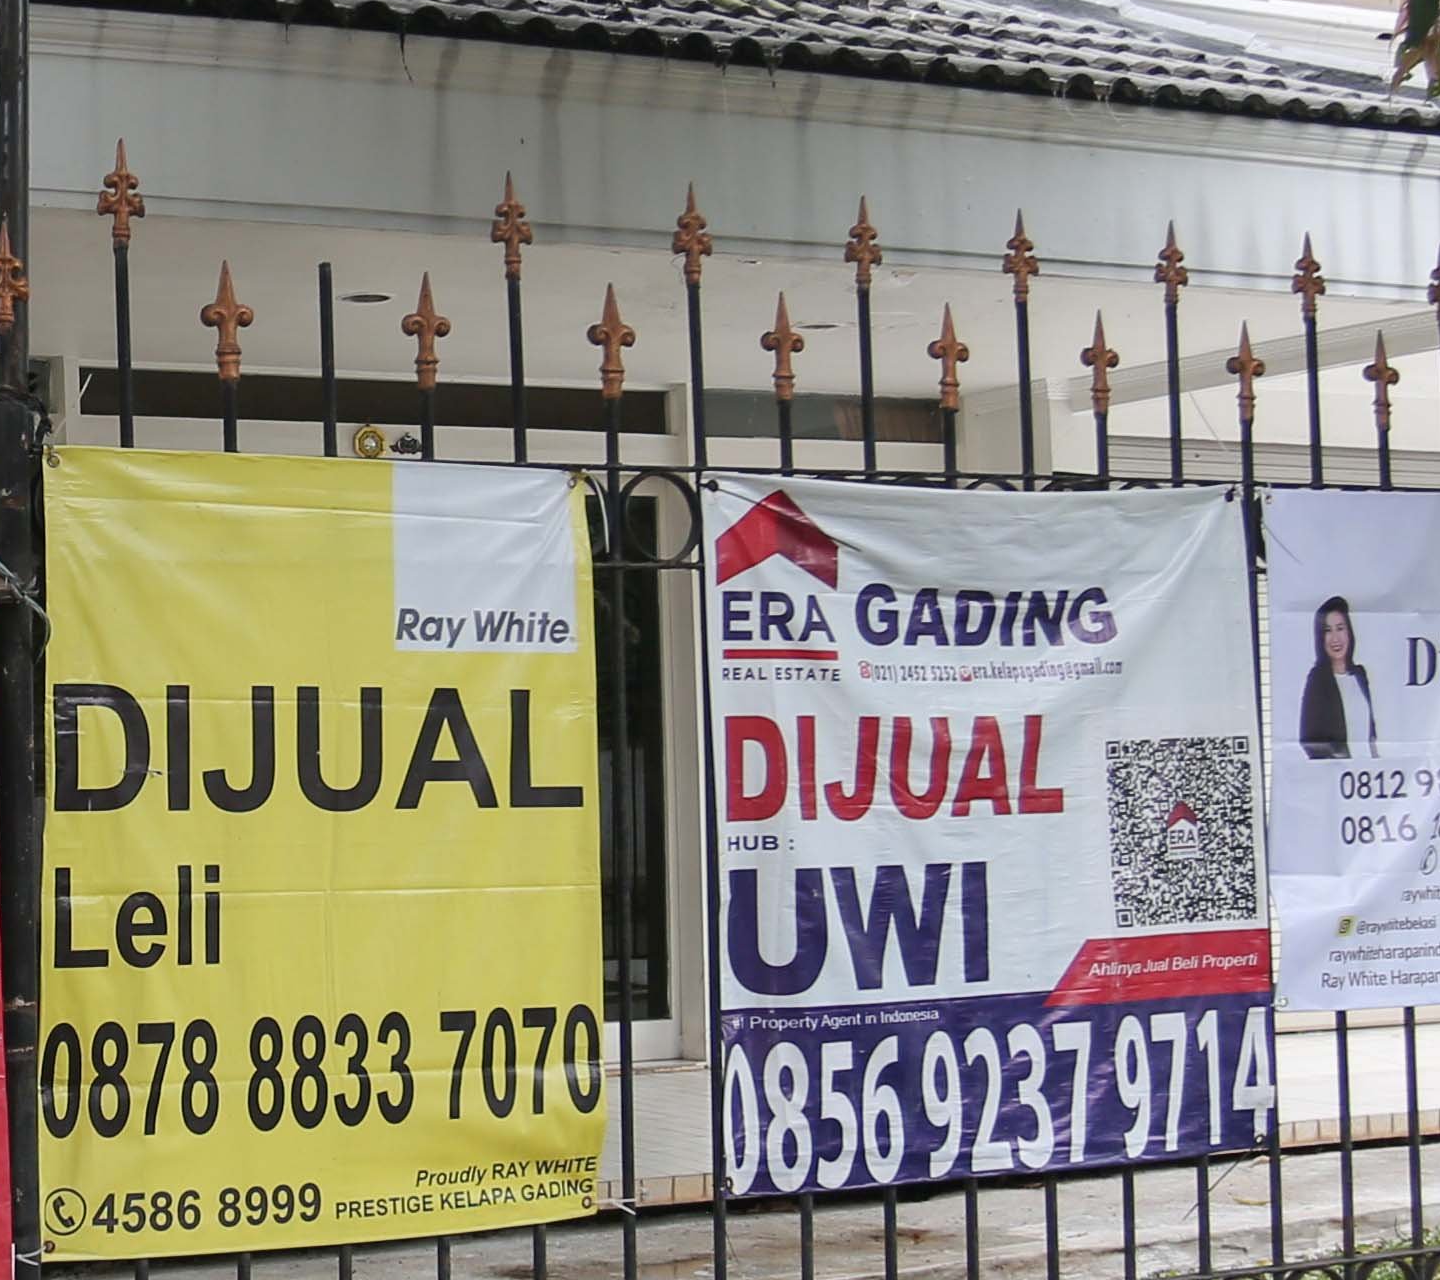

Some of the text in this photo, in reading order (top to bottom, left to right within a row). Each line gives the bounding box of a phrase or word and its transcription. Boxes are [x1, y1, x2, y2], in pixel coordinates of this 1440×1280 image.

[396, 609, 570, 648] Ray White
[722, 590, 836, 642] ERA
[855, 583, 1119, 647] GADING
[722, 667, 841, 682] REAL ESTATE
[53, 683, 584, 813] DIJUAL
[724, 714, 1064, 822] DIJUAL
[1340, 770, 1408, 799] 0812
[727, 835, 779, 851] HUB
[1341, 813, 1418, 845] 0816
[53, 864, 223, 970] Leli
[727, 861, 990, 995] UWI
[1088, 953, 1258, 977] Ahlinya Jual Beli Properti
[1322, 972, 1345, 990] Ray
[1349, 971, 1386, 988] White
[750, 1016, 818, 1031] Property
[822, 1013, 862, 1029] Agent
[865, 1013, 877, 1024] in
[880, 1009, 939, 1023] Indonesia
[43, 1002, 602, 1140] 0878 8833 7070
[723, 1006, 1275, 1196] 0856 9237 9714
[416, 1156, 597, 1188] Proudly RAY WHITE
[92, 1182, 322, 1234] 4586 8999
[335, 1178, 593, 1220] PRESTIGE KELAPA GADING
